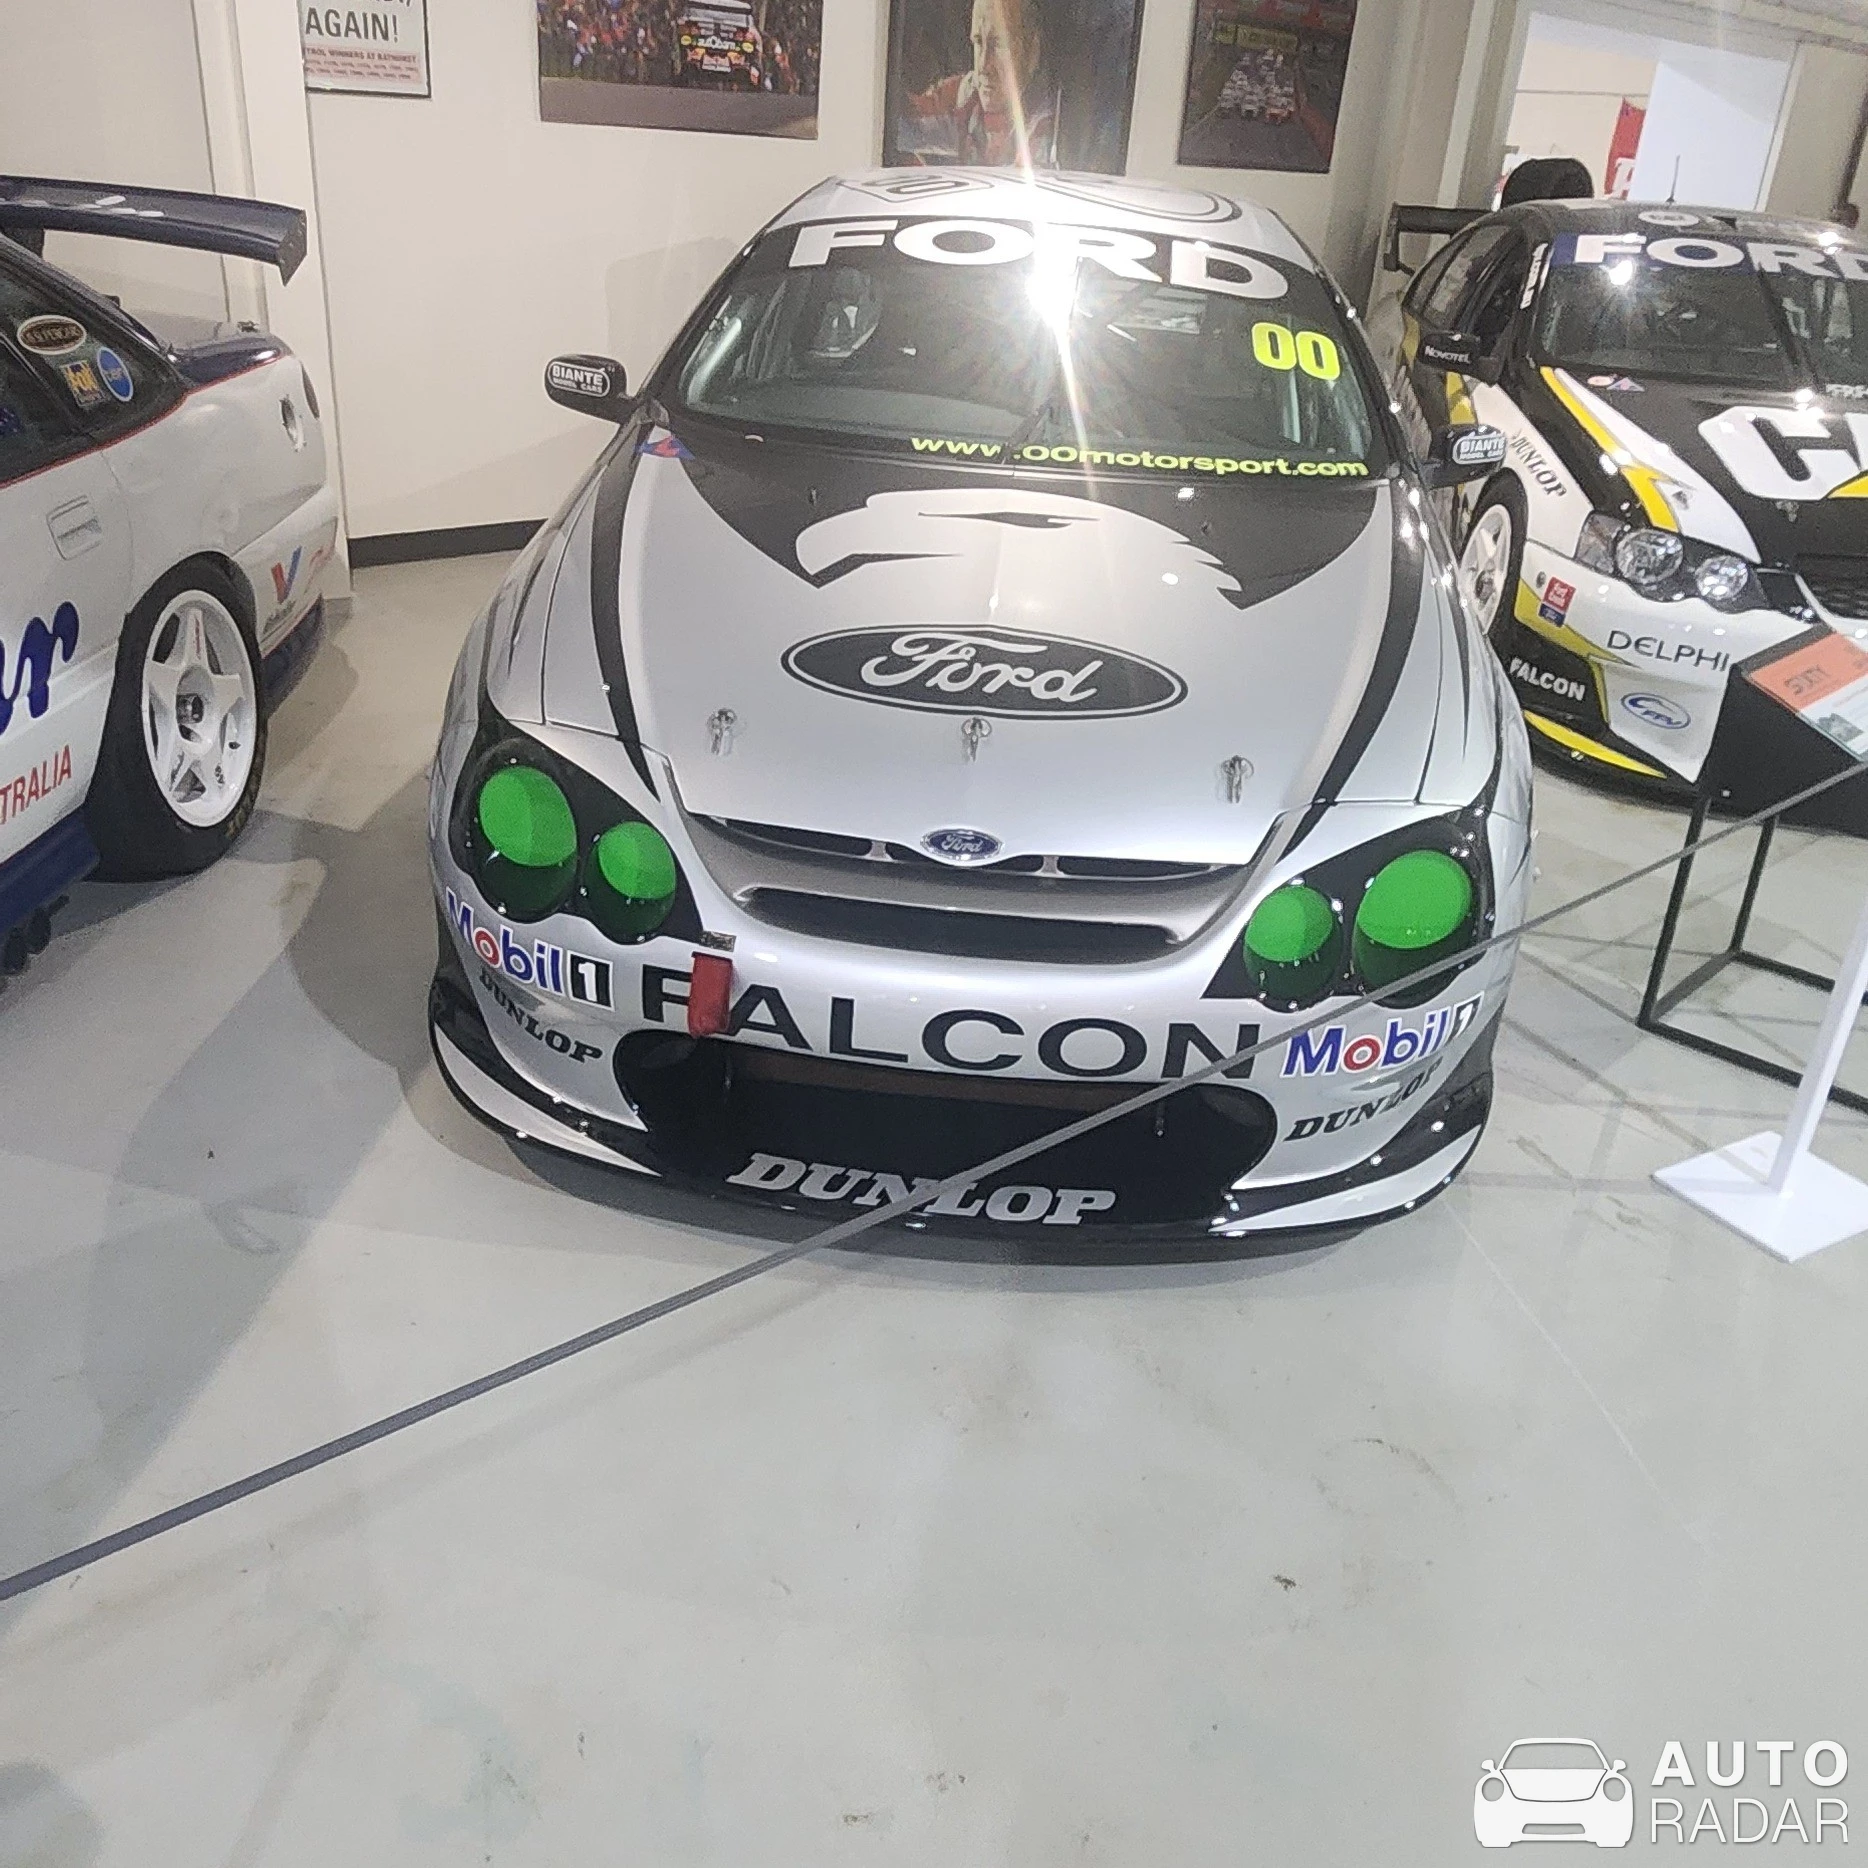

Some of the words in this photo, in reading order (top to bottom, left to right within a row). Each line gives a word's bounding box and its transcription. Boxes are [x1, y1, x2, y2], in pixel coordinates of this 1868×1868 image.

[305, 7, 398, 43] AGAIN!
[788, 219, 1288, 299] FORD
[552, 365, 603, 386] BIANTE
[1252, 322, 1341, 381] 00
[1424, 345, 1471, 364] NOVOTEL
[1510, 436, 1567, 497] DUNLOP
[861, 633, 1103, 702] Ford
[1509, 656, 1586, 701] FALCON
[1606, 629, 1730, 672] DELPHI
[941, 834, 983, 852] Ford
[480, 966, 604, 1064] DUNLOP
[641, 964, 1261, 1080] FALCON
[1283, 1056, 1443, 1142] DUNLOP
[725, 1152, 1116, 1225] DUNLOP
